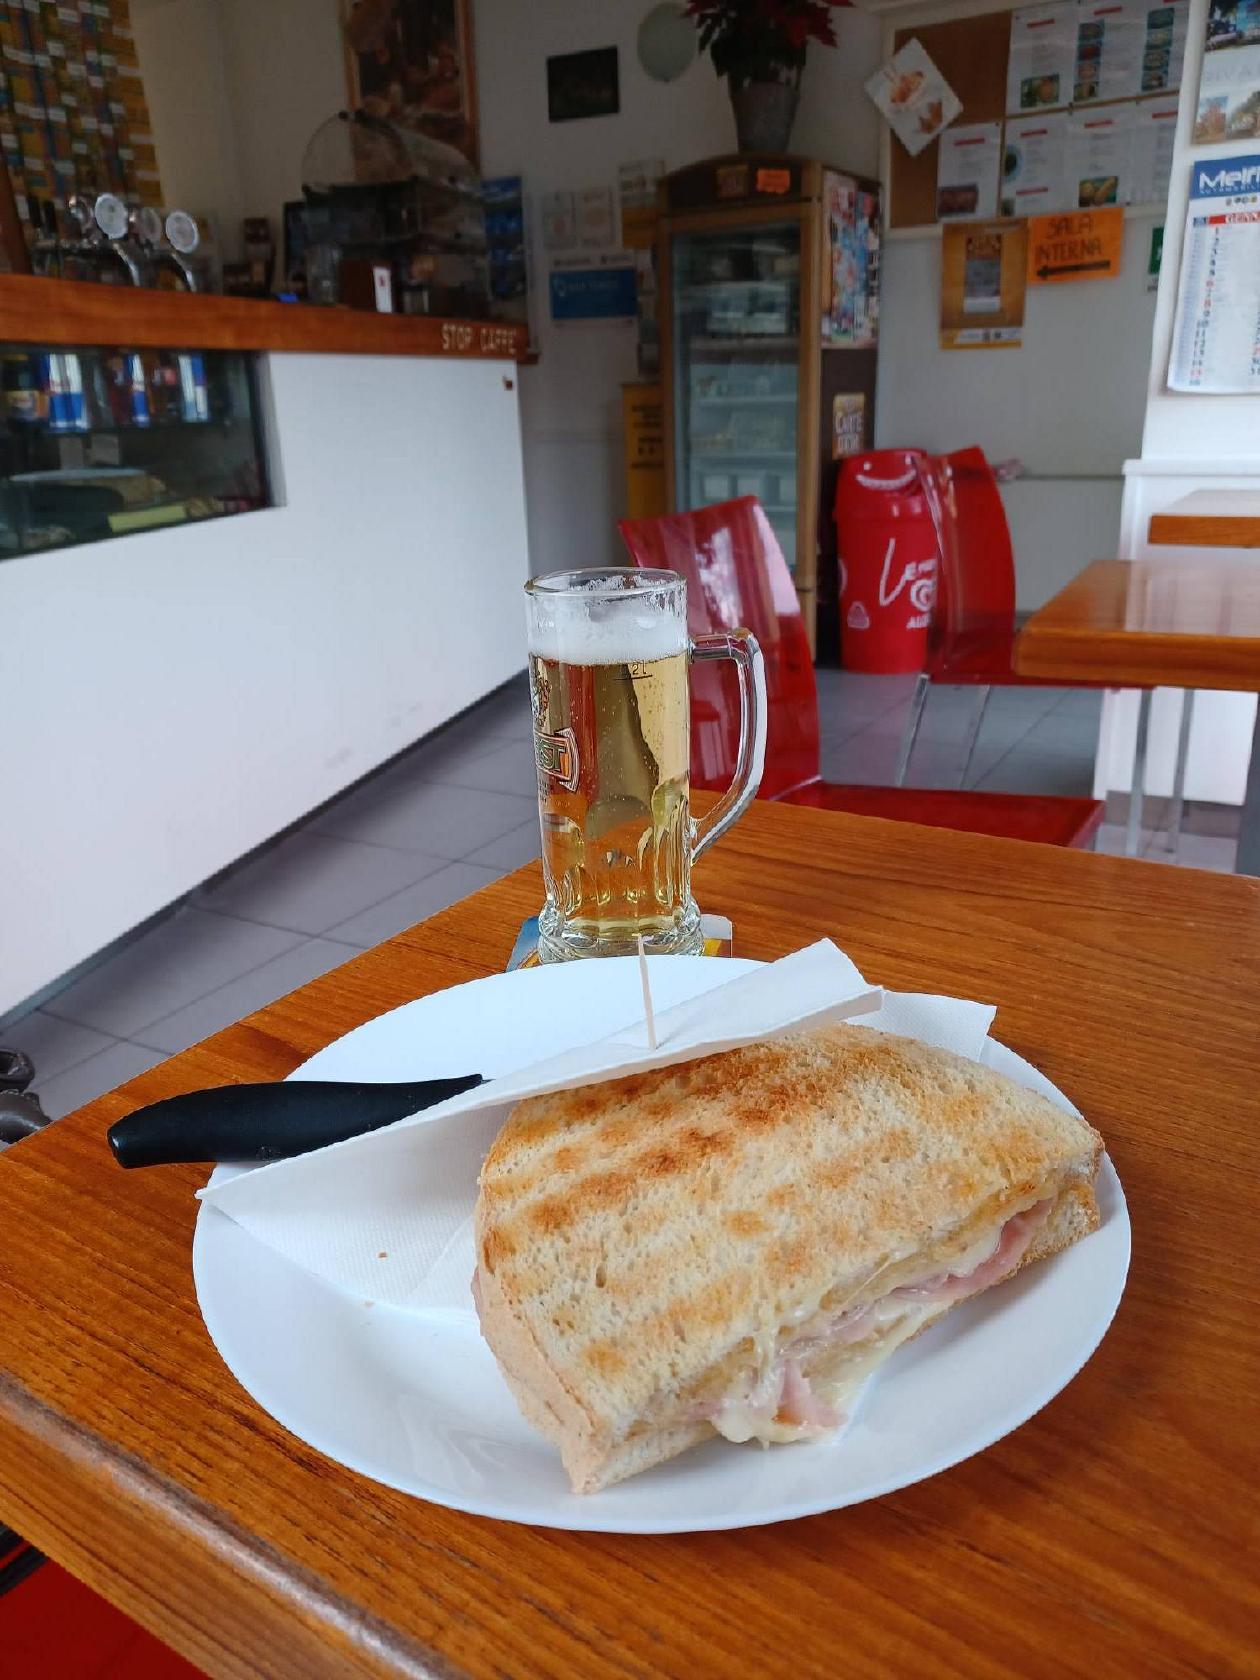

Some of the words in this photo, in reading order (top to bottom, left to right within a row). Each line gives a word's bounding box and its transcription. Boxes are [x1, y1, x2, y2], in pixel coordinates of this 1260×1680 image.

[1045, 213, 1093, 240] SALA
[1035, 239, 1102, 264] INTERNA
[442, 323, 473, 351] STOP
